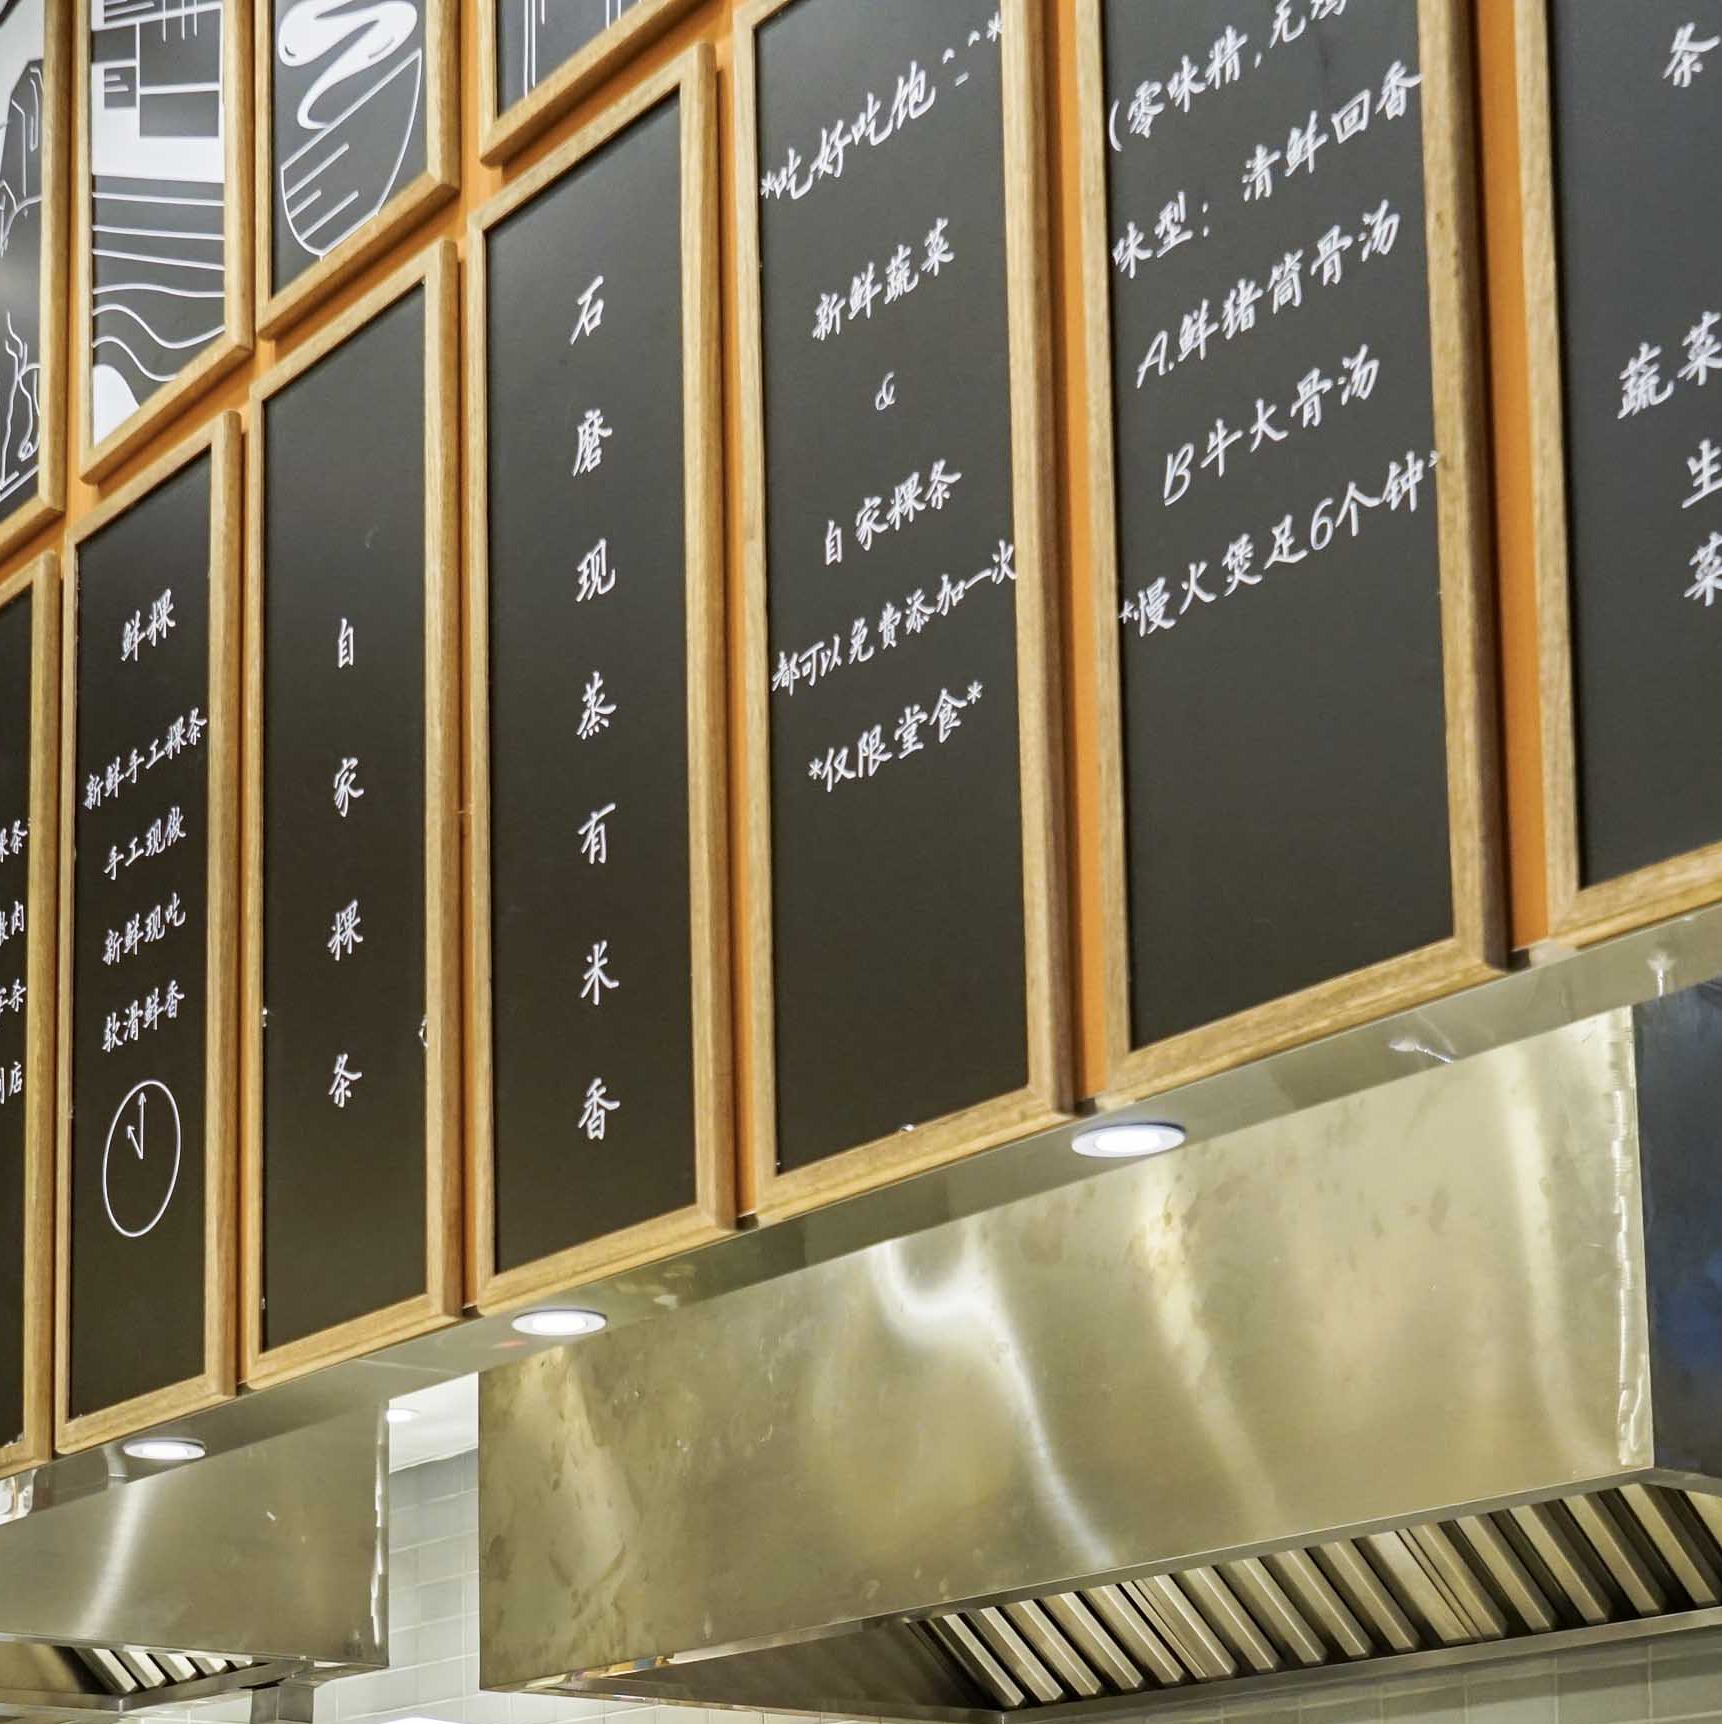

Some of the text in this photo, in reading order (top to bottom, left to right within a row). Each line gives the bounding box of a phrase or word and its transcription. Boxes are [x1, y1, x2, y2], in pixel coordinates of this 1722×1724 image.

[812, 217, 955, 341] 新鲜蔬菜
[824, 459, 962, 566] 自家粿条
[120, 588, 177, 662] 鲜粿
[772, 539, 1018, 696] 都可以免费添加一次
[84, 706, 209, 810] 新鲜手工粿条
[102, 806, 188, 881] 手工现做
